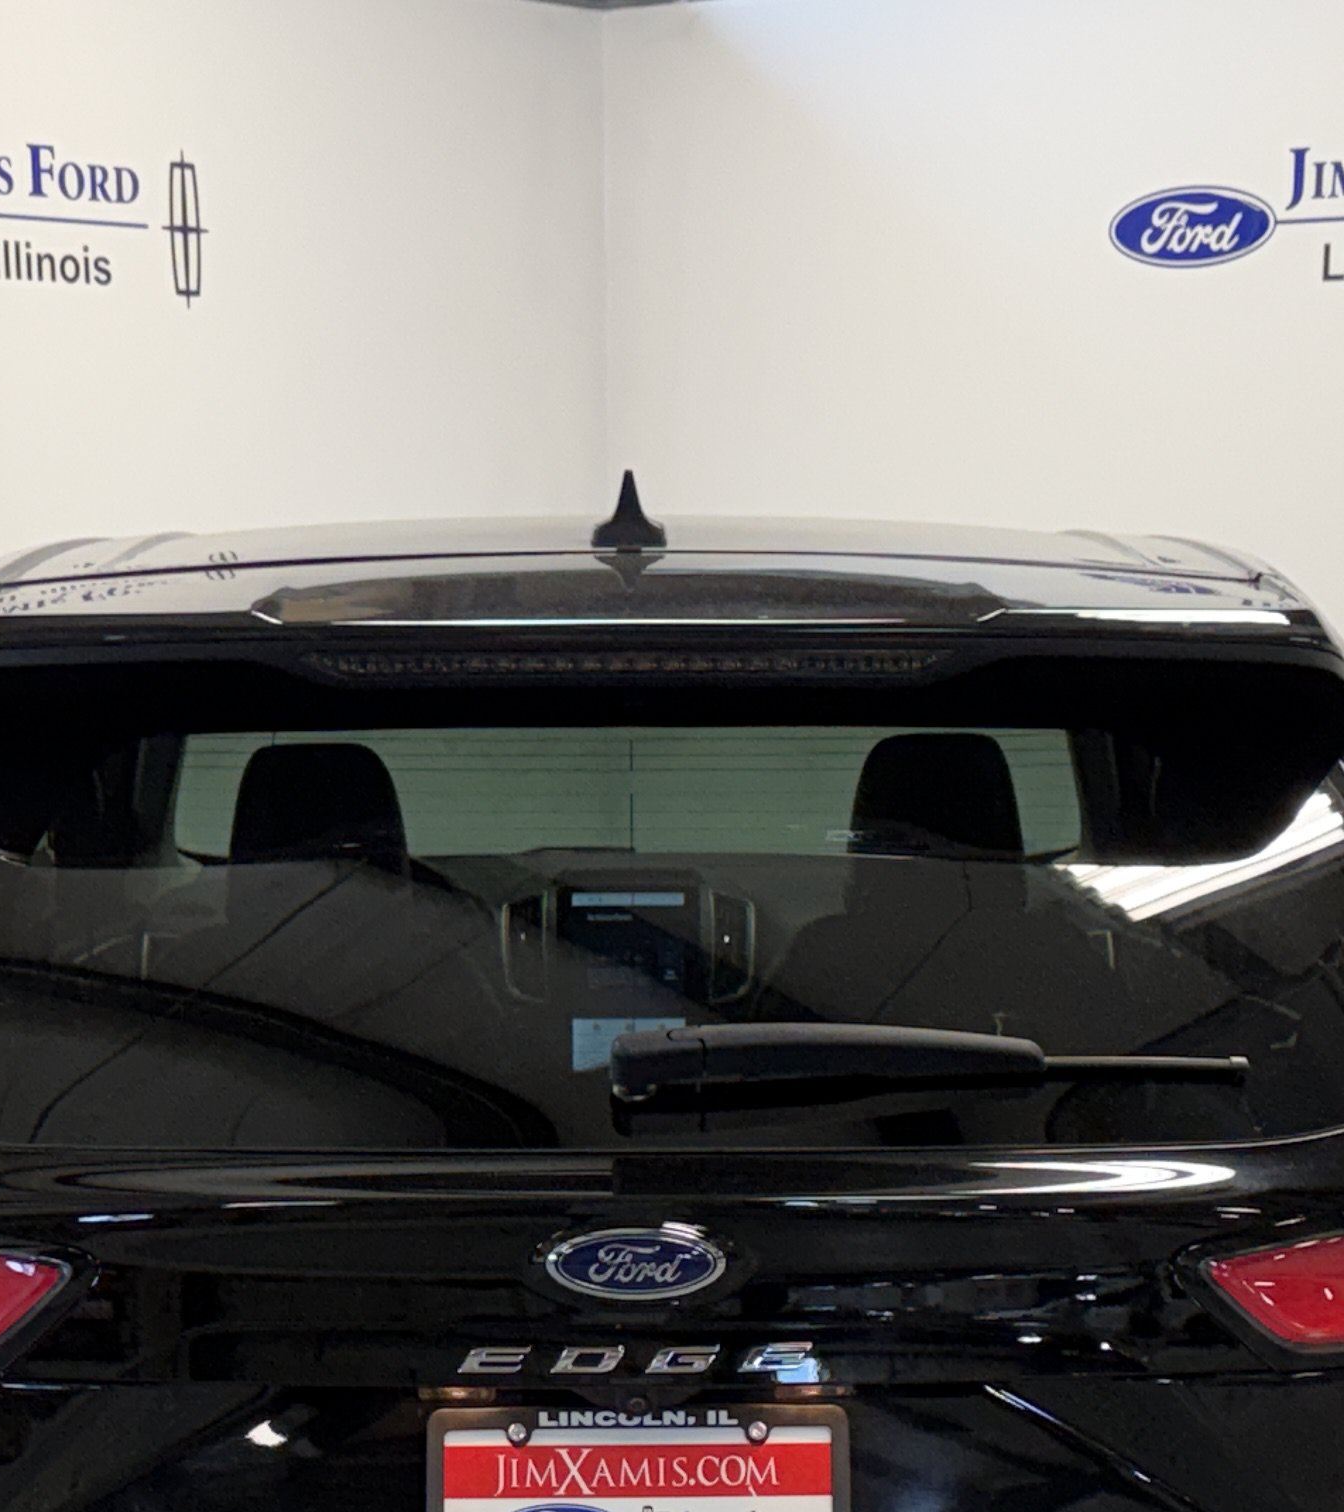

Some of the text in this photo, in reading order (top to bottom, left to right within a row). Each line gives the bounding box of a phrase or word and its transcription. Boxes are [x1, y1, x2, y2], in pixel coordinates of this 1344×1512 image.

[26, 143, 141, 204] FORD
[1140, 201, 1240, 255] Ford
[587, 1242, 690, 1284] Ford
[457, 1341, 814, 1376] EDGE
[707, 1410, 739, 1426] IL
